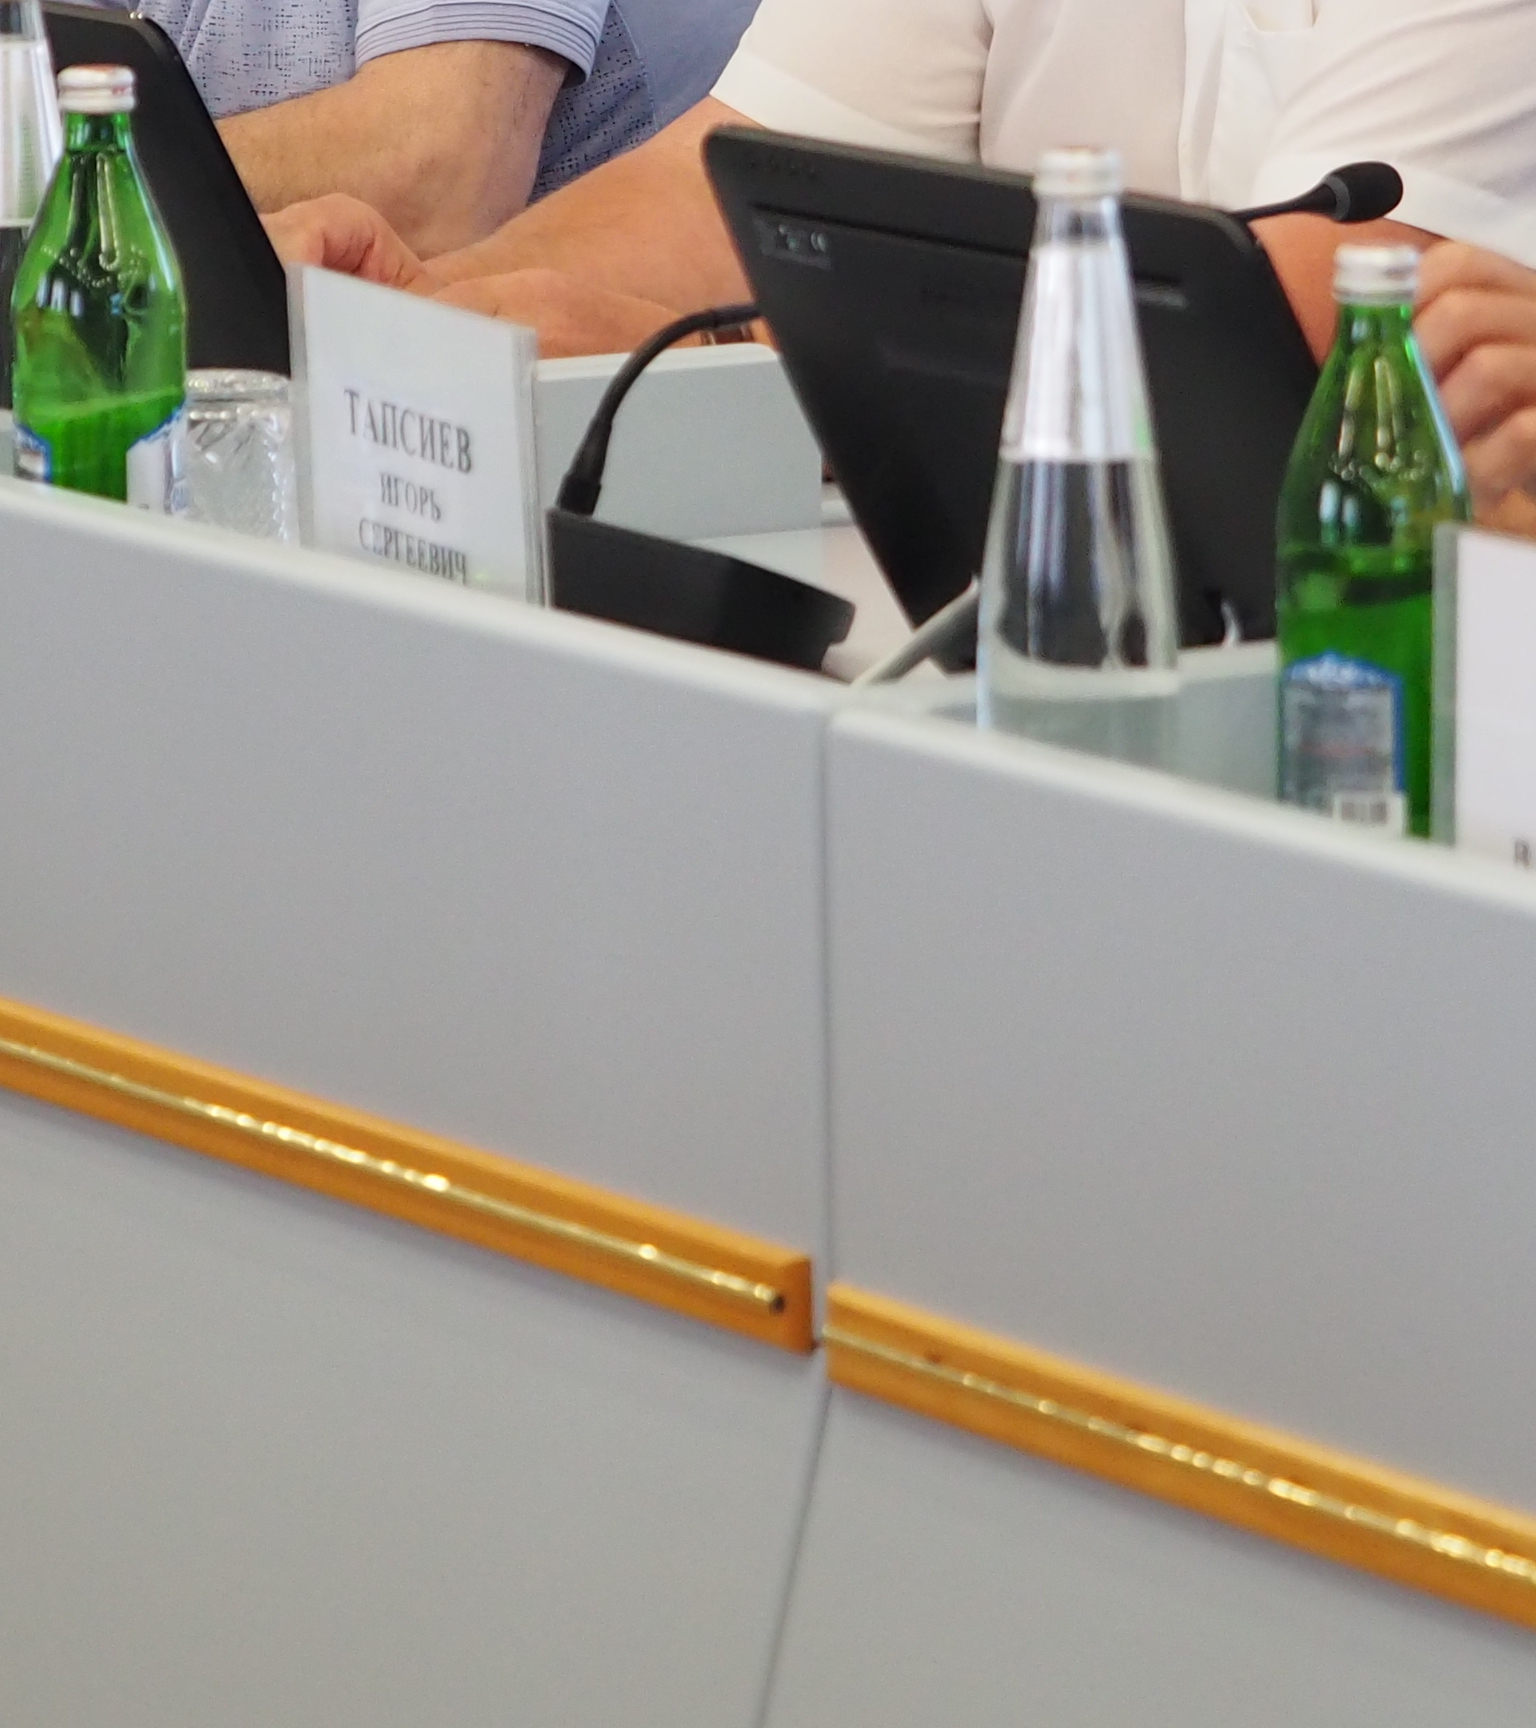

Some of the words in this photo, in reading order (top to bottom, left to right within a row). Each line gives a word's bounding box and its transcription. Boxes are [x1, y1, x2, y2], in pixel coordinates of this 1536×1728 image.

[344, 389, 472, 473] ТАПСИЕВ
[380, 474, 441, 521] ИГОРЬ
[359, 518, 469, 584] СЕРГЕЕВИЧ
